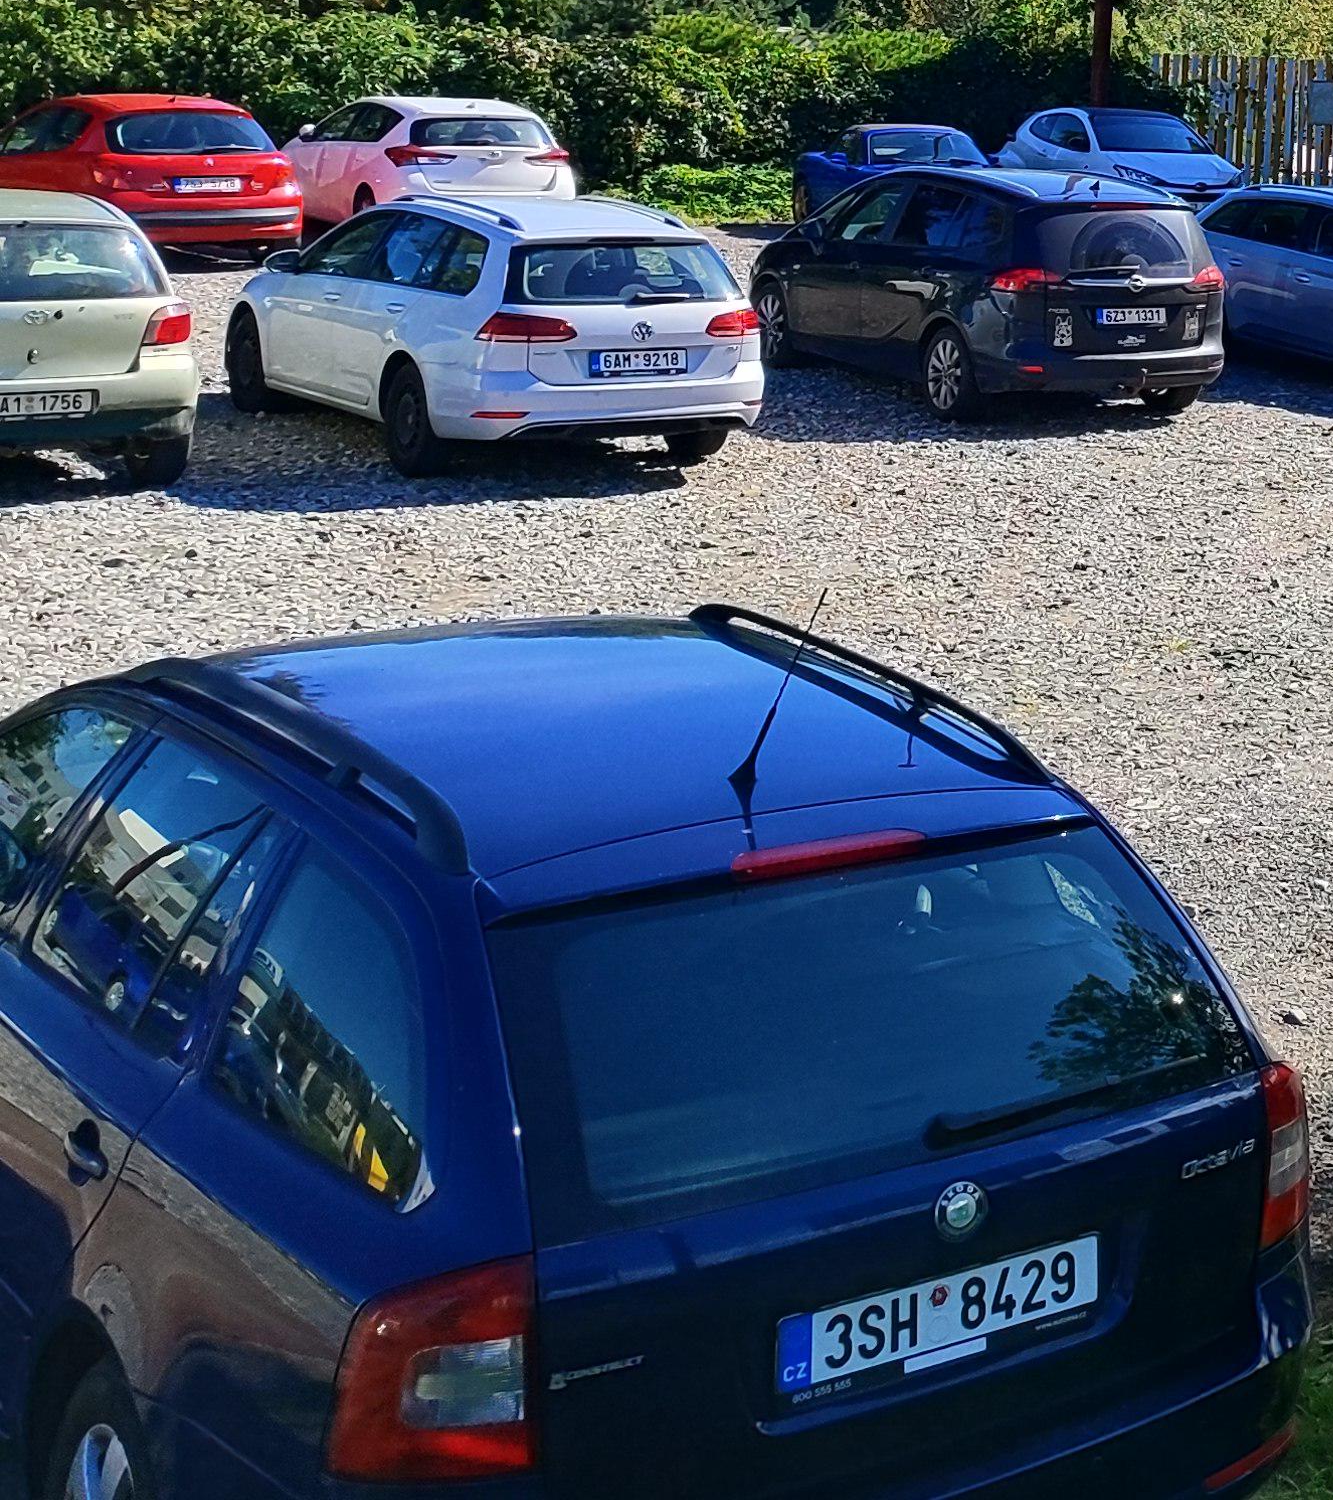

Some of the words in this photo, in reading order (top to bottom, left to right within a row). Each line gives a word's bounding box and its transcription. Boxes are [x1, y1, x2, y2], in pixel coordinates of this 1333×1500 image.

[1105, 310, 1126, 322] 6Z3
[603, 354, 631, 369] 6AM
[643, 352, 679, 367] 9218
[39, 394, 83, 411] 1756
[1181, 1138, 1256, 1179] Octavia
[824, 1293, 918, 1370] 3SH
[960, 1251, 1076, 1331] 8429
[783, 1361, 808, 1383] CZ
